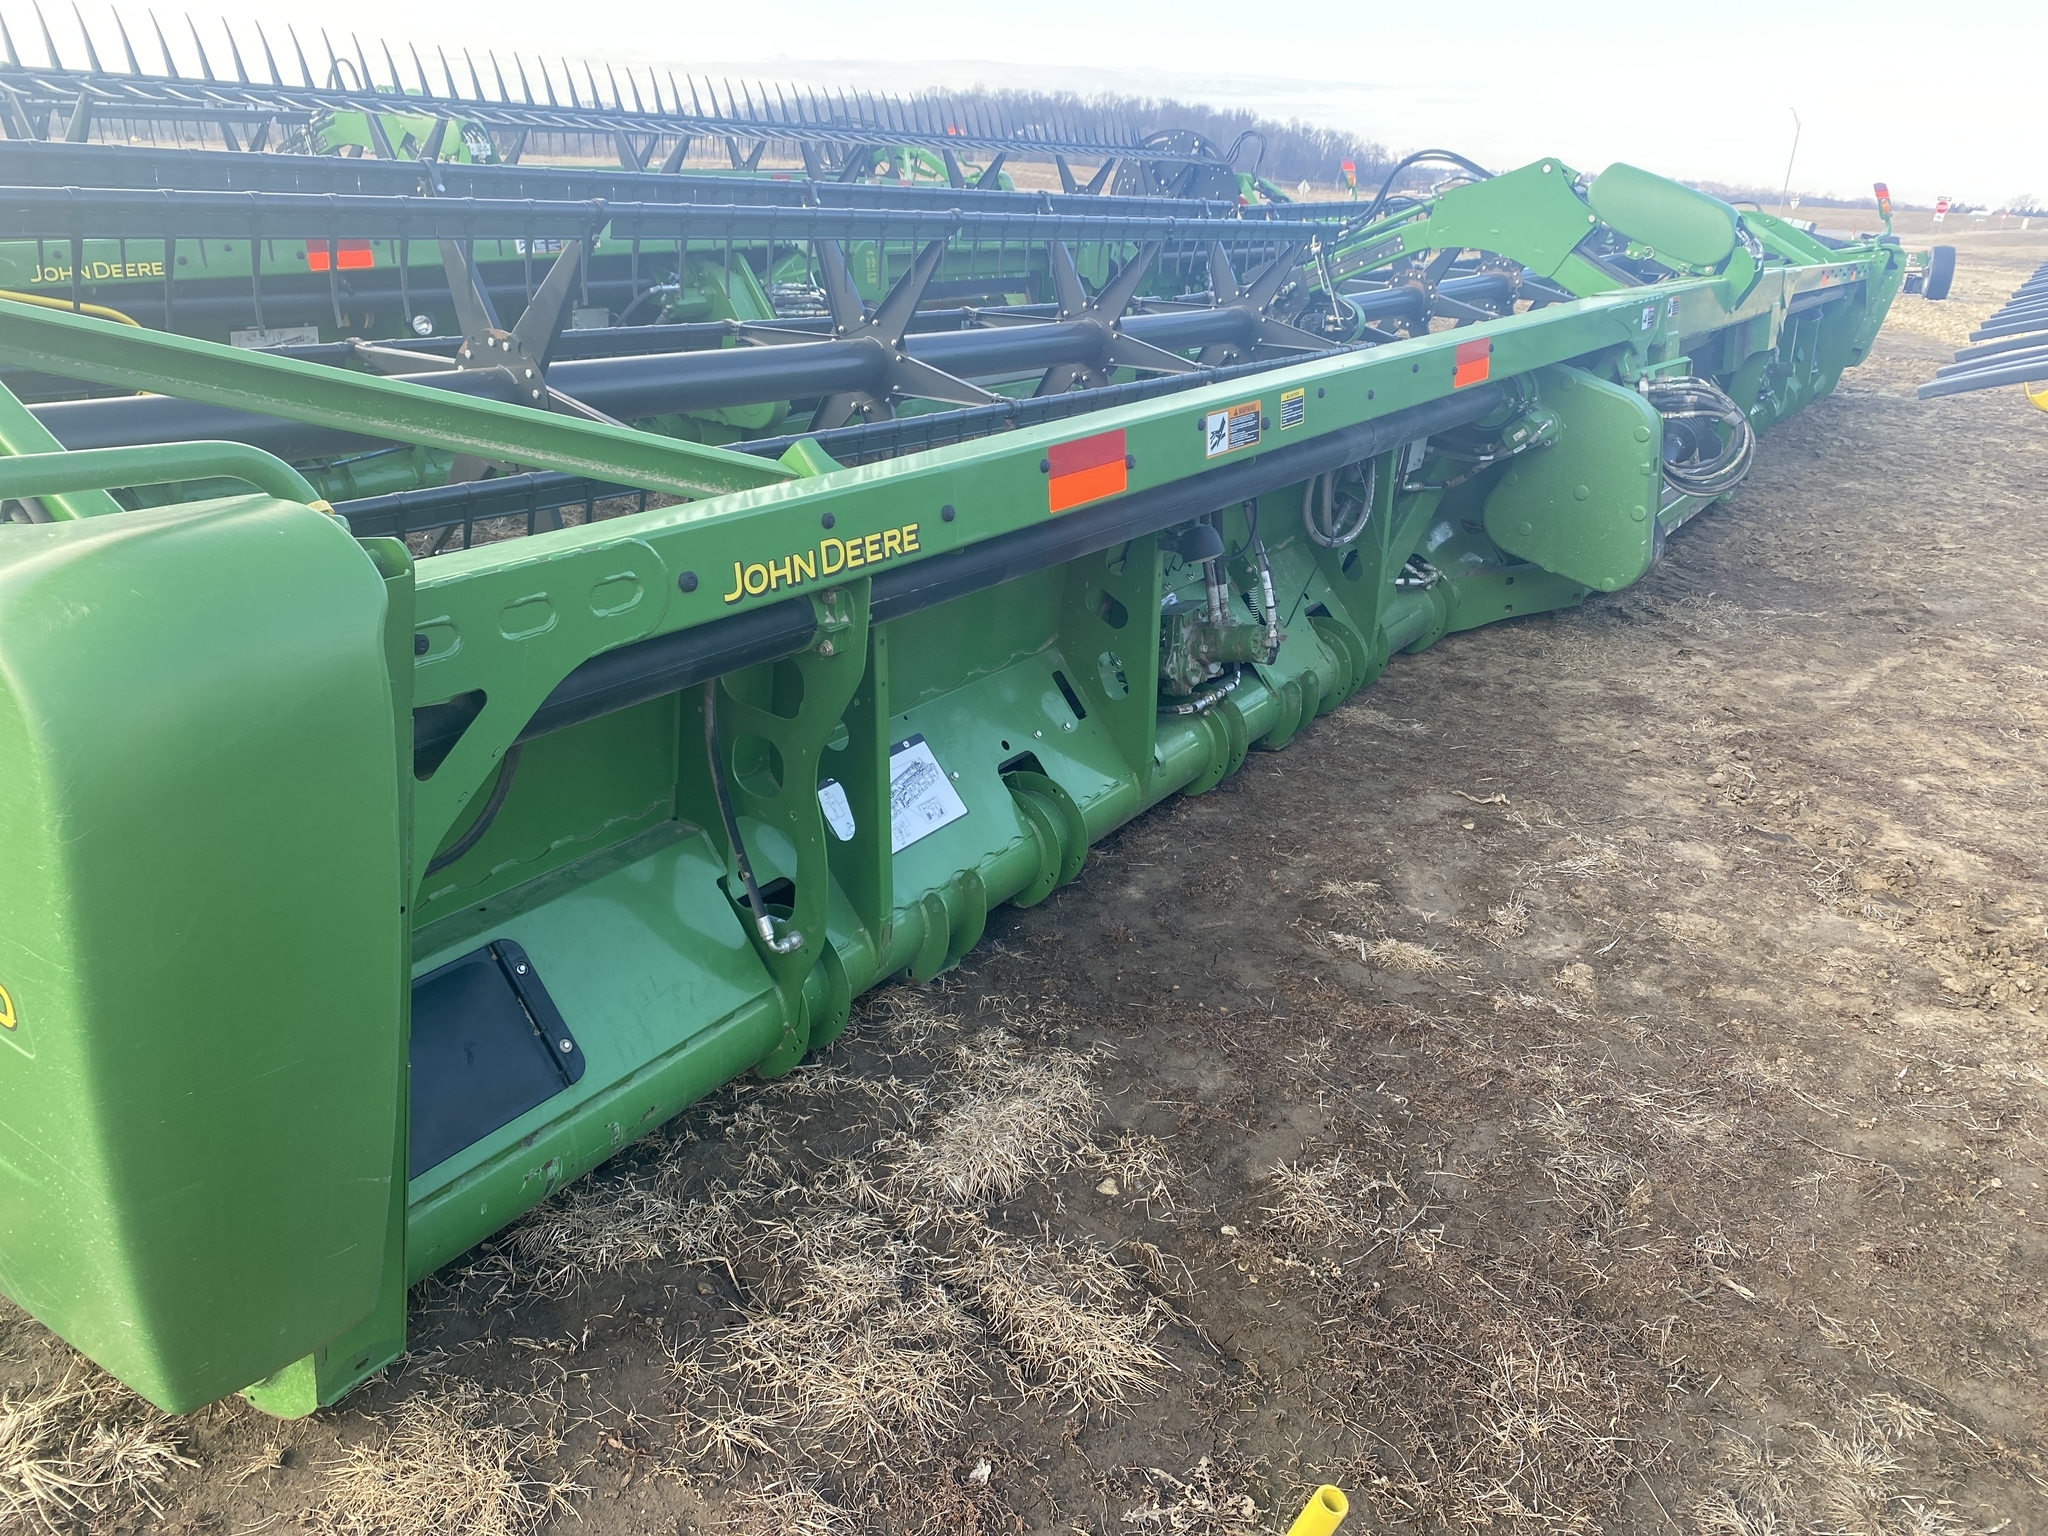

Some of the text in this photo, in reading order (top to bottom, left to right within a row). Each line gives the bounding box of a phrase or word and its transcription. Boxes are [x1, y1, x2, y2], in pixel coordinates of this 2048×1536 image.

[30, 261, 165, 283] JOHN DEERE
[723, 522, 920, 604] JOHN DEERE
